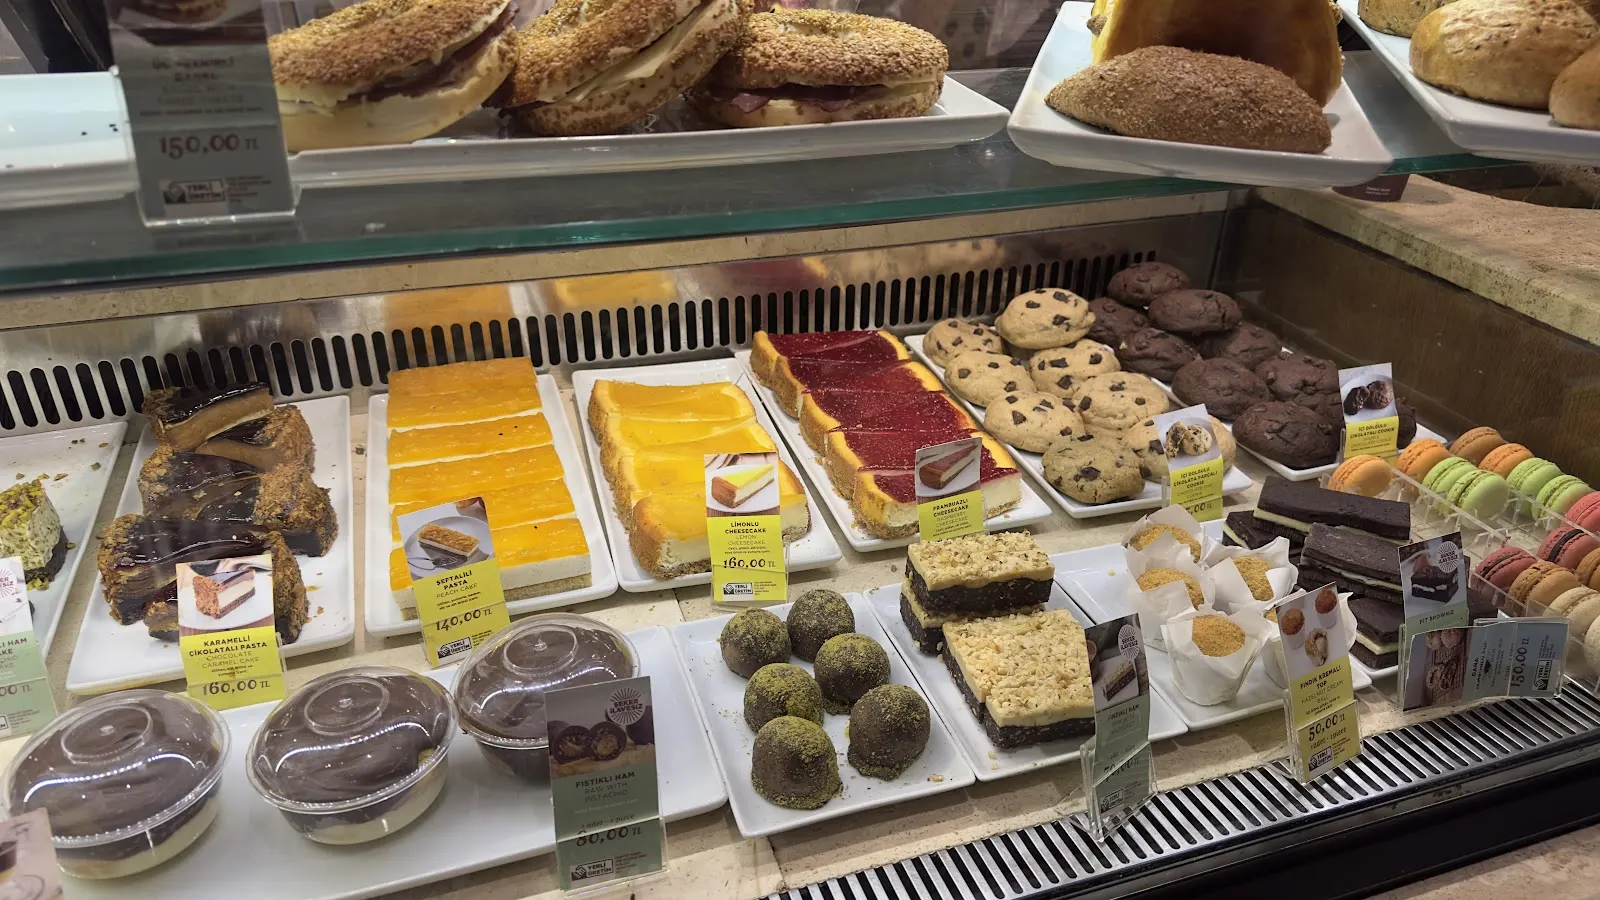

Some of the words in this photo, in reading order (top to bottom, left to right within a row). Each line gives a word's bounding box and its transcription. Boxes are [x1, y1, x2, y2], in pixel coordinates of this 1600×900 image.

[159, 134, 240, 160] 150,00
[1186, 480, 1205, 489] COOKIE
[933, 505, 969, 518] CHEESECAKE
[723, 556, 766, 569] 160,00
[767, 560, 776, 568] TL
[436, 588, 459, 599] PEACH
[460, 582, 478, 592] CAKE
[443, 579, 468, 590] PASTA
[435, 609, 482, 631] 140,00
[483, 608, 493, 617] TL
[7, 637, 28, 647] HAM
[203, 634, 251, 647] KARAMELLİ
[240, 641, 268, 650] PASTA
[201, 659, 238, 669] CARAMEL
[239, 656, 260, 664] CAKE
[205, 650, 253, 662] CHOCOLATE
[1509, 647, 1528, 688] 150,00
[21, 684, 33, 693] TL
[202, 679, 257, 696] 160,00
[259, 681, 271, 689] TL
[1316, 680, 1328, 690] TOP
[1308, 714, 1338, 742] 50,00
[575, 775, 613, 789] FISTIKLI
[615, 771, 635, 781] HAM
[584, 786, 604, 795] RAW
[606, 781, 628, 791] WITH
[584, 789, 629, 802] PISTACHIO
[576, 826, 629, 847] 80,00
[631, 827, 643, 836] TL
[587, 862, 606, 870] YERLİ
[587, 867, 612, 876] ÜRETİM
